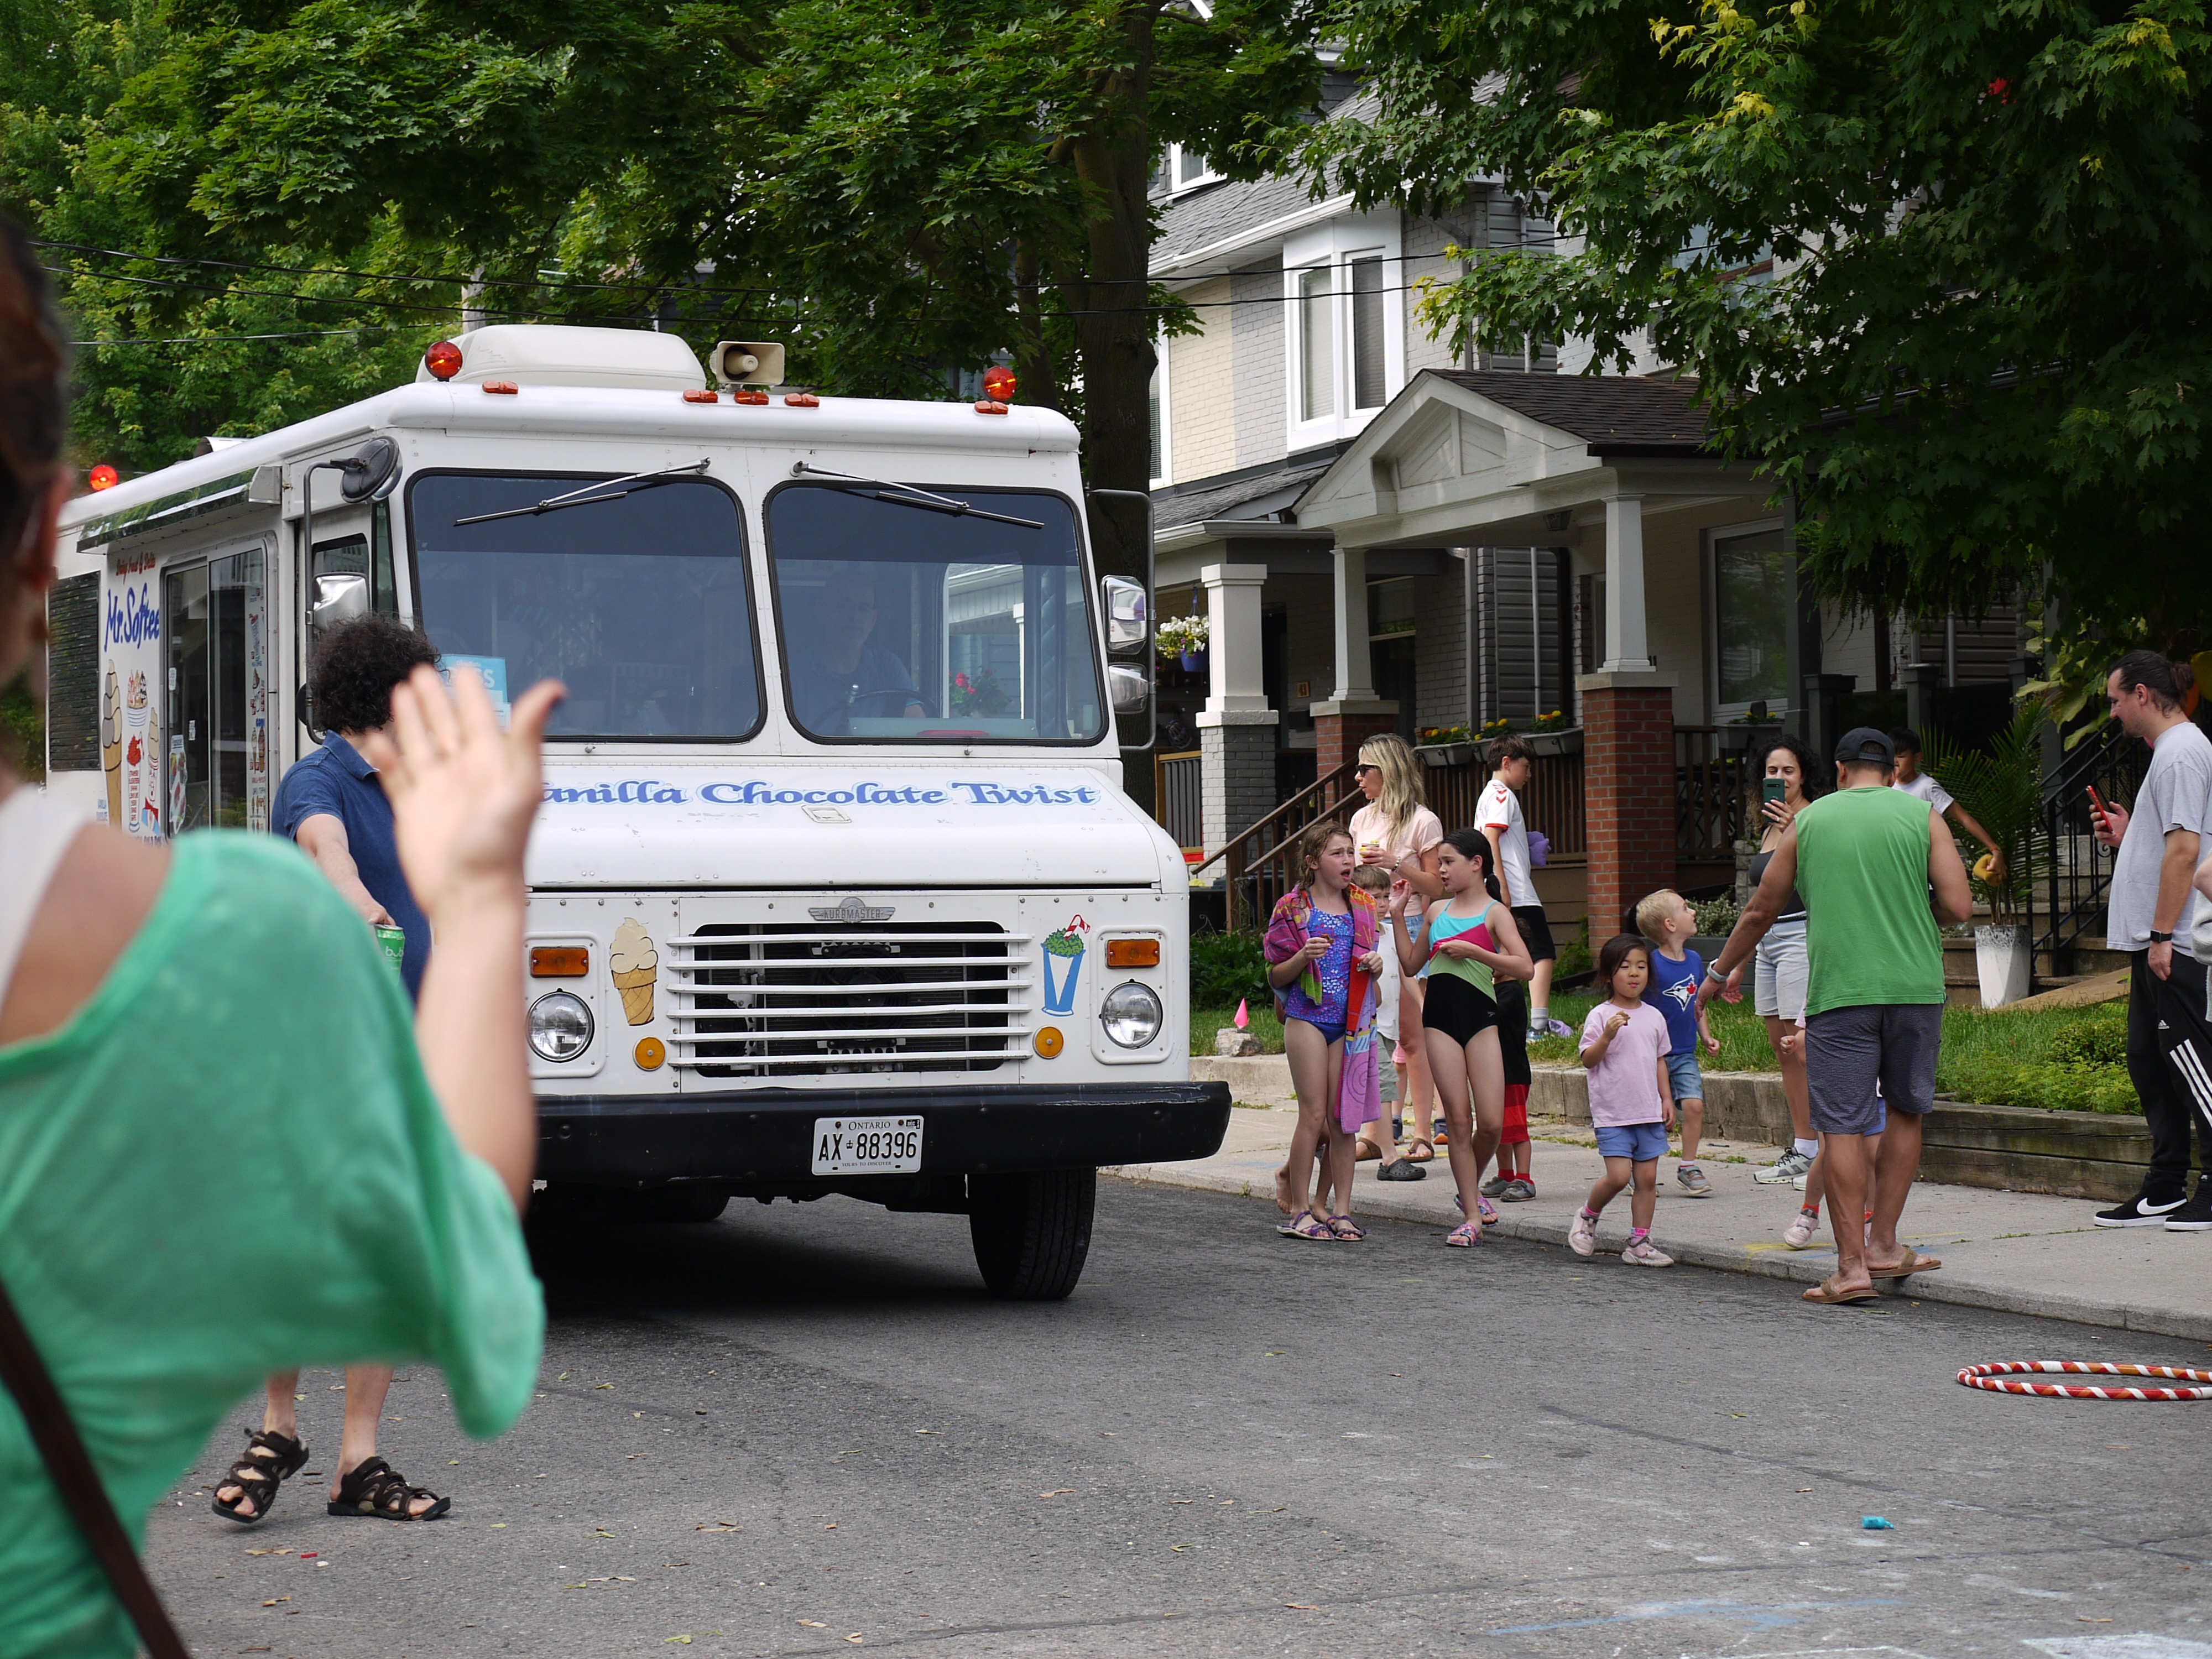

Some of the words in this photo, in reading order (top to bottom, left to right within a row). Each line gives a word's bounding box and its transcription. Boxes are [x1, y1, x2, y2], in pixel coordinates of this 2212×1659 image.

[104, 588, 123, 653] Mr.
[124, 582, 159, 650] Softee
[540, 780, 689, 804] anilla
[701, 781, 948, 804] Chocolate
[950, 782, 1098, 804] Twist
[824, 909, 880, 919] KURBMASTER
[848, 1121, 890, 1131] ONTARIO
[818, 1134, 843, 1161] AX
[856, 1132, 917, 1160] 88396
